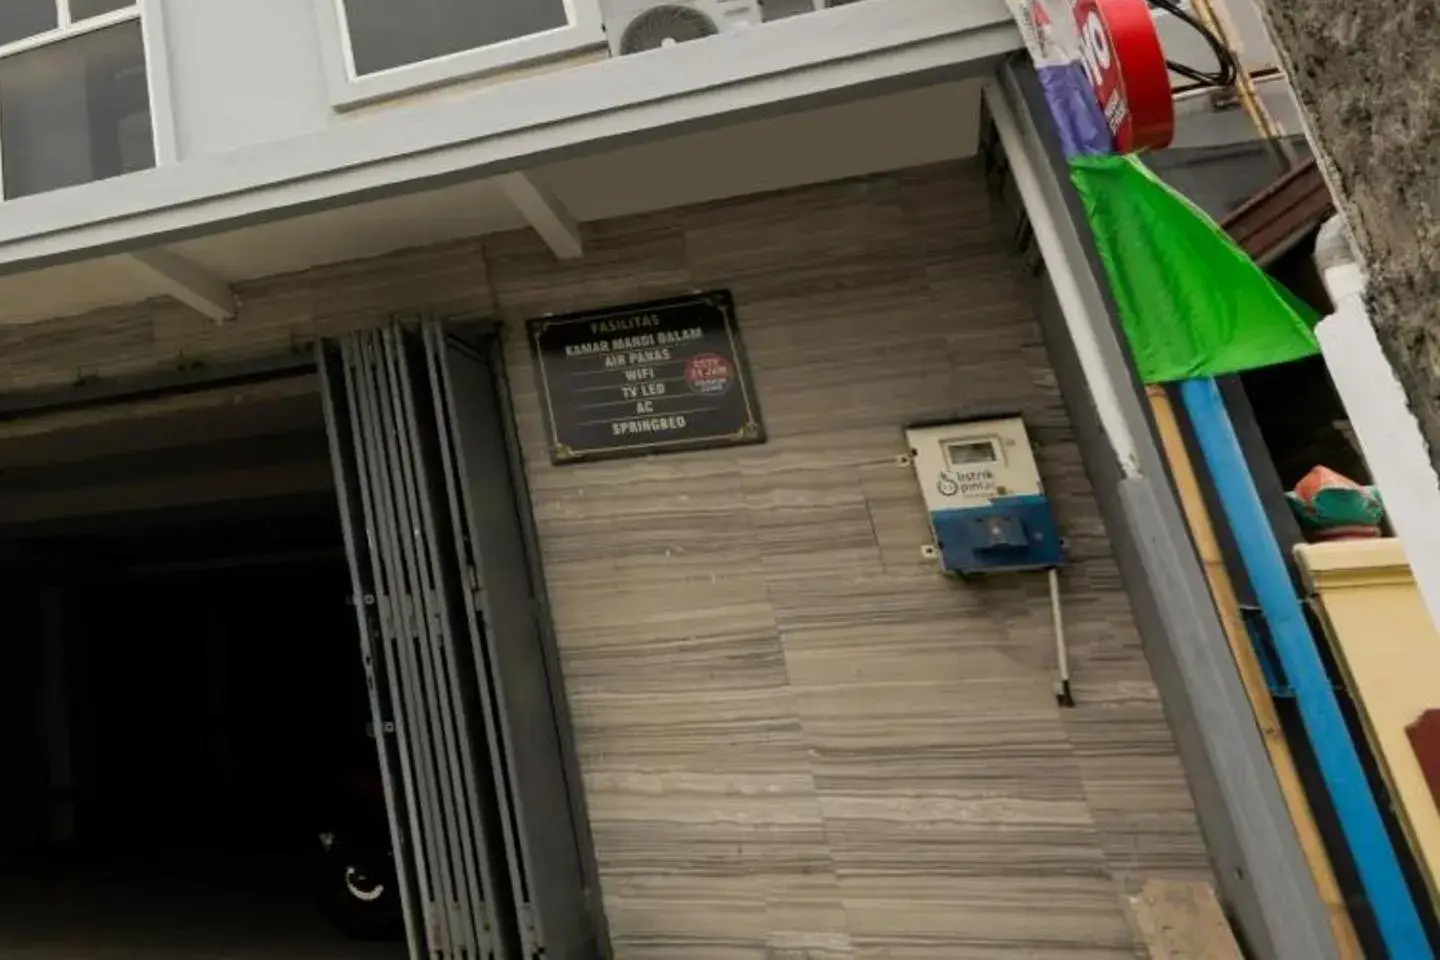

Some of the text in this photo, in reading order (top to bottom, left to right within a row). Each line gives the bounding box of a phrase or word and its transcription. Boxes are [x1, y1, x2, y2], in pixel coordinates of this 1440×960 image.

[591, 314, 660, 334] FASILITAS
[565, 327, 703, 356] KAMAR MANDI DALAM
[605, 348, 671, 368] AIR PANAS
[625, 368, 655, 380] WIFI
[622, 383, 665, 399] TV LED
[636, 400, 654, 414] AC
[612, 415, 687, 436] SPRINGBED
